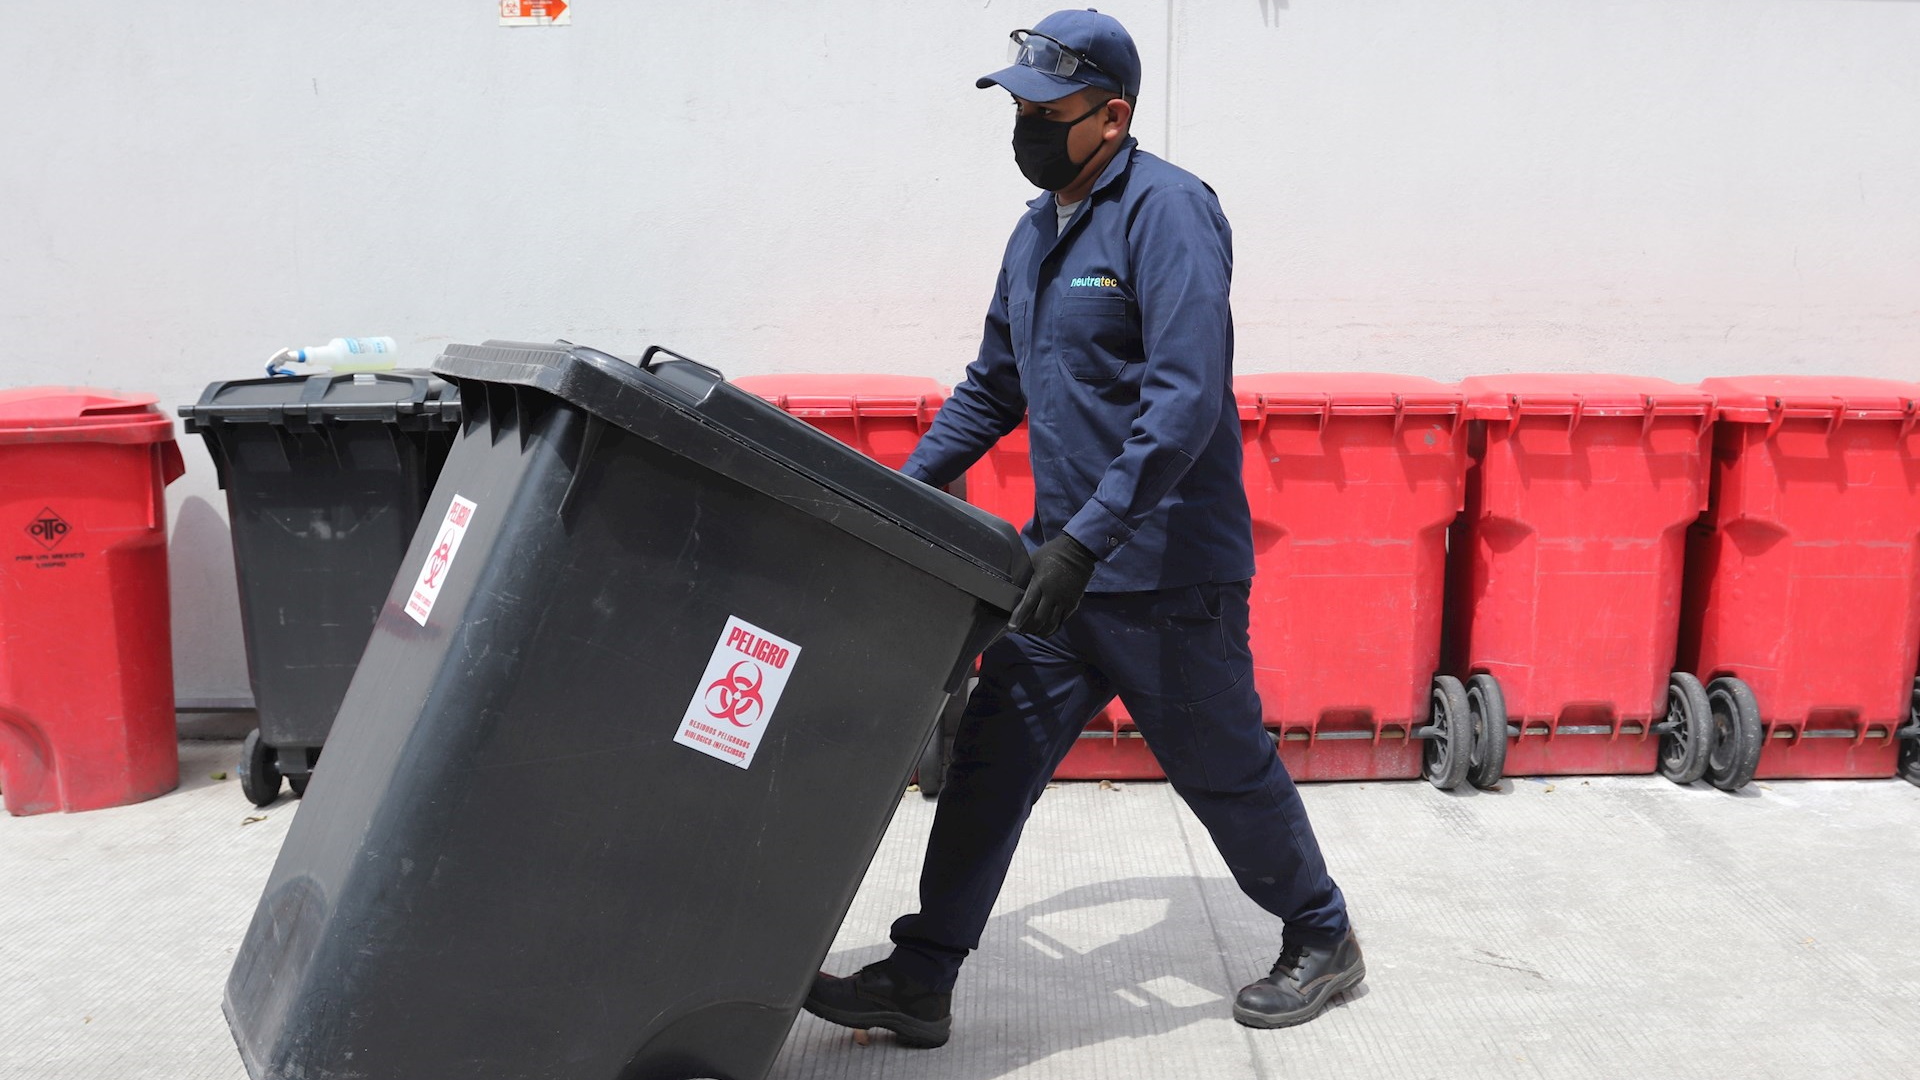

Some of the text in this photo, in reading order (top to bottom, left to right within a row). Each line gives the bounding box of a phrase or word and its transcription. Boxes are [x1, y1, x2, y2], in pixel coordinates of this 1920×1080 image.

[1070, 276, 1117, 288] neutratec
[725, 626, 790, 670] PELIGRO
[684, 729, 746, 759] BIOLOGICO INFECCIOSOS
[688, 719, 750, 748] RESIDUOS PELIGROSOS
